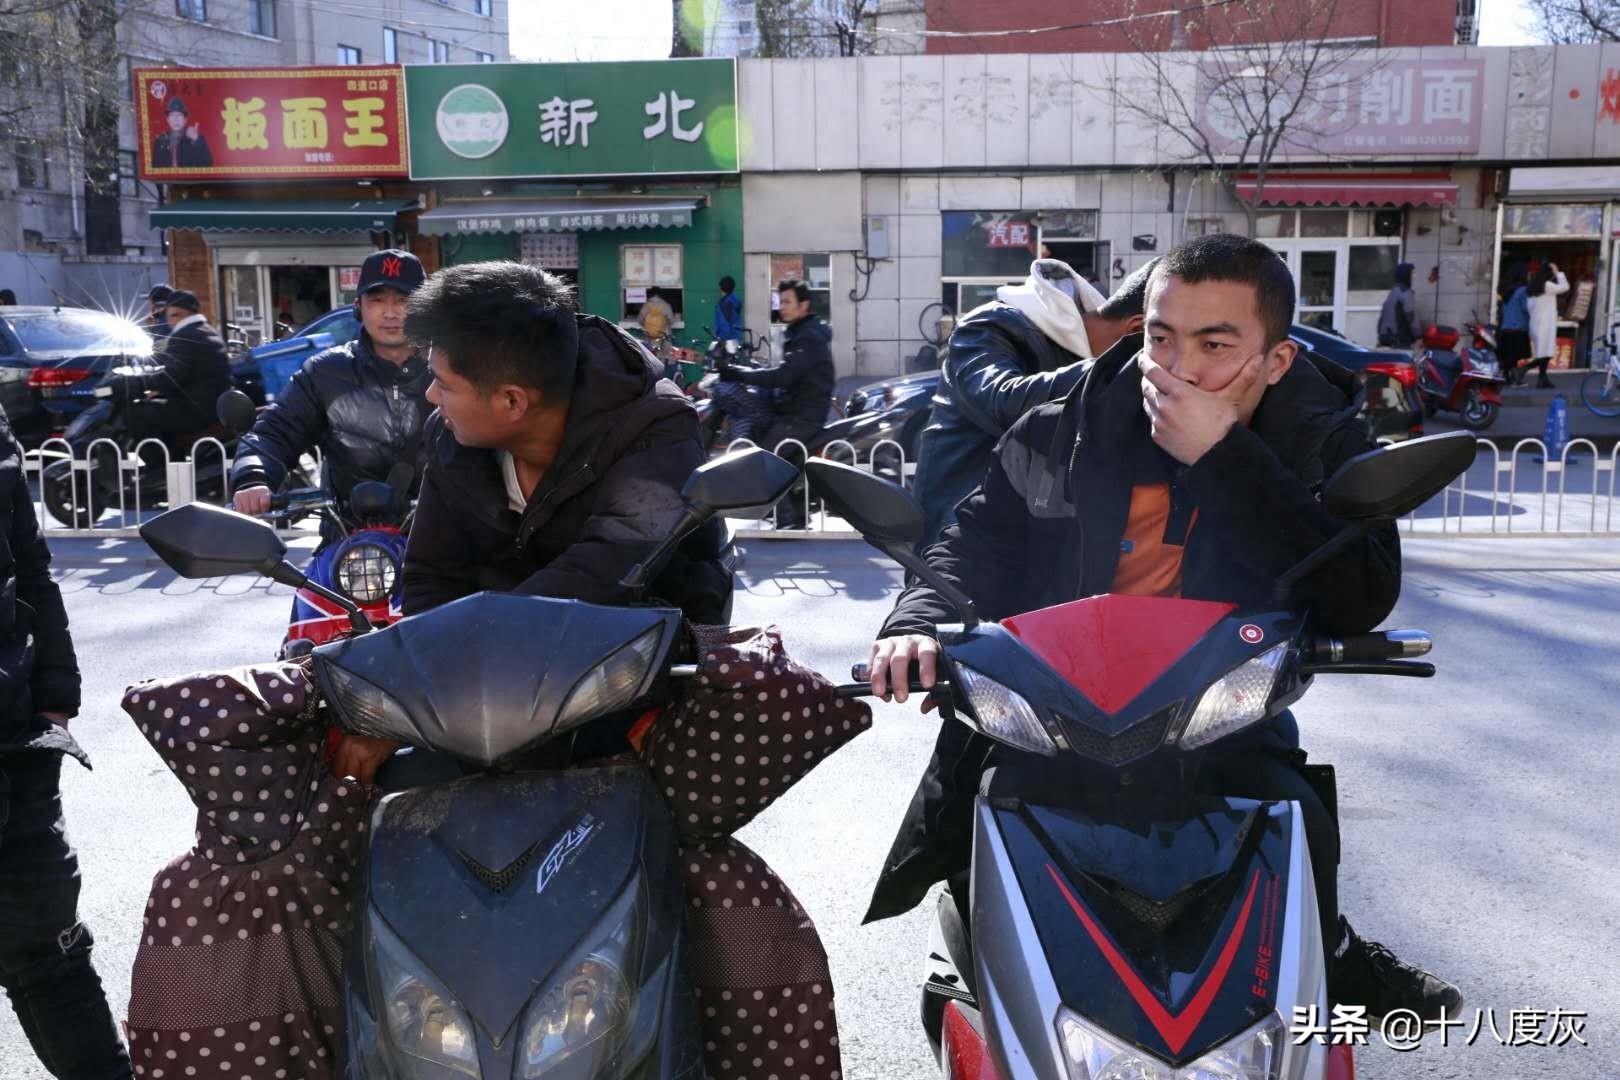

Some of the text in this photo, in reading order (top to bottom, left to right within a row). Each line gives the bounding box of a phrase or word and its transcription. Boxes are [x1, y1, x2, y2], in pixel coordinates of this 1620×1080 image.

[221, 97, 388, 149] 板面王
[538, 89, 703, 146] 新北
[1303, 69, 1477, 125] 刀削面
[457, 218, 502, 231] 汉堡炸鸡
[560, 214, 605, 227] 台式奶茶
[990, 223, 1030, 245] 汽配
[1251, 944, 1273, 998] E-BIKE
